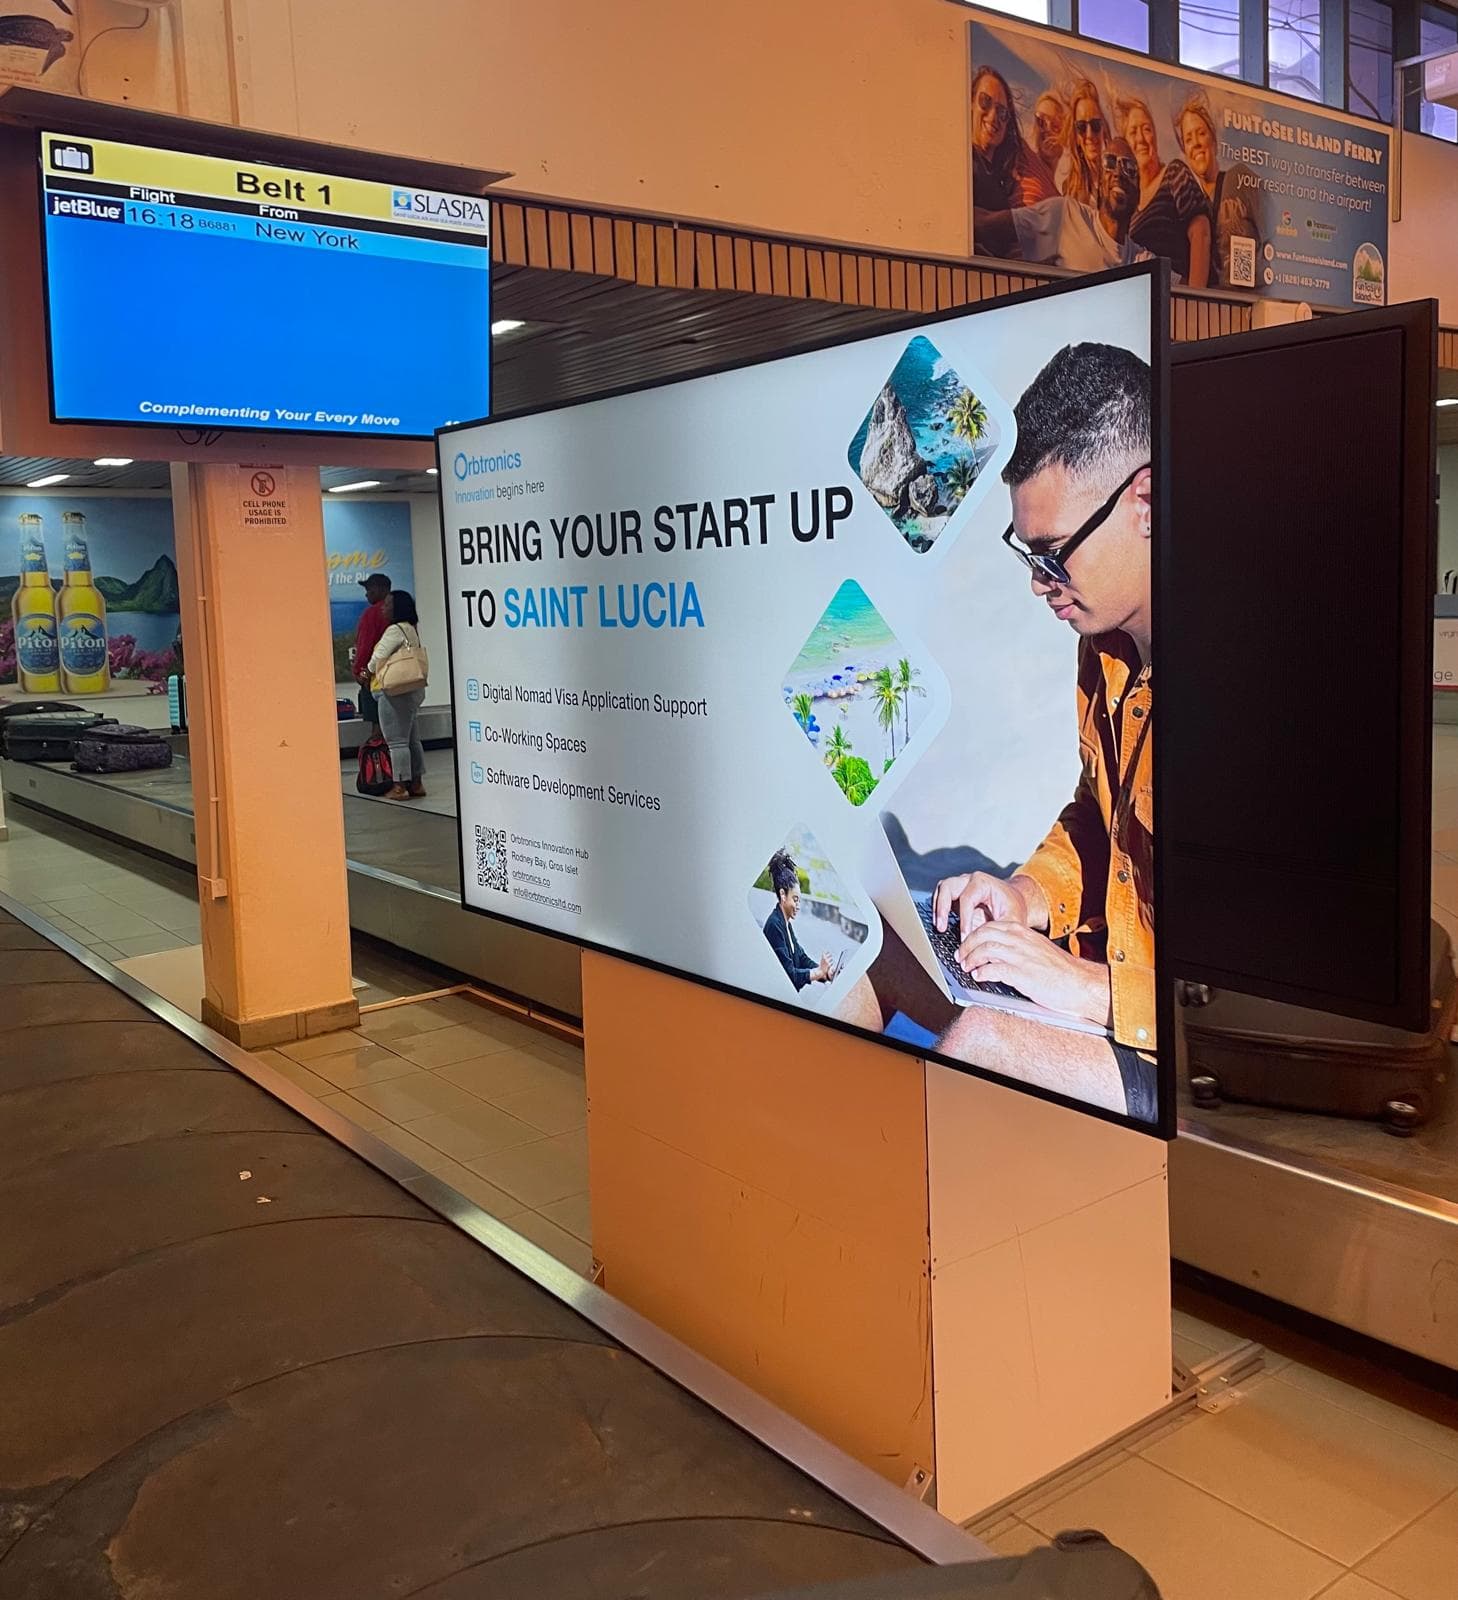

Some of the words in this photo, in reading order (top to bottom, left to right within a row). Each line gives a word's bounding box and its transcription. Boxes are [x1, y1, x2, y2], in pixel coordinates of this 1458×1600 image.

[1296, 126, 1342, 155] ISLAND
[1343, 137, 1383, 165] FERRY
[1220, 141, 1241, 160] The
[1241, 146, 1271, 166] BEST
[1270, 157, 1293, 175] way
[1294, 161, 1304, 175] to
[1304, 162, 1346, 184] transfer
[1345, 171, 1386, 195] between
[129, 186, 176, 205] Flight
[236, 171, 306, 203] Belt
[317, 184, 331, 206] 1
[1236, 172, 1262, 190] your
[1263, 177, 1295, 196] resort
[1296, 183, 1317, 201] and
[1318, 188, 1335, 205] the
[1336, 192, 1373, 213] airport!
[52, 197, 121, 220] jetBlue
[258, 204, 299, 221] From
[413, 194, 485, 222] SLASPA
[127, 206, 195, 231] 16:18
[198, 218, 238, 232] B6881
[255, 221, 306, 243] New
[312, 229, 360, 250] York
[139, 400, 271, 421] Complementing
[274, 408, 312, 422] Your
[314, 410, 357, 425] Every
[361, 413, 401, 427] Move
[454, 449, 522, 480] Orbtronics
[243, 500, 260, 509] CELL
[261, 501, 286, 509] PHONE
[455, 486, 495, 504] Innovation
[496, 482, 524, 501] begins
[525, 480, 545, 495] here
[244, 517, 287, 526] PROHIBITED
[248, 509, 273, 517] USAGE
[274, 509, 282, 517] IS
[458, 519, 543, 566] BRING
[549, 509, 643, 560] YOUR
[653, 493, 776, 554] START
[789, 485, 854, 544] UP
[326, 548, 388, 570] ome
[335, 572, 353, 586] the
[354, 572, 370, 586] Pit
[460, 589, 497, 629] TO
[503, 584, 589, 629] SAINT
[598, 580, 706, 629] LUCIA
[61, 636, 105, 649] Piton
[1433, 670, 1453, 683] ge
[482, 683, 513, 704] Digital
[515, 685, 552, 705] Nomad
[554, 688, 579, 706] Visa
[581, 690, 650, 712] Application
[653, 693, 708, 719] Support
[484, 725, 543, 751] Co-Working
[545, 732, 587, 753] Spaces
[486, 767, 530, 790] Software
[532, 774, 605, 801] Development
[608, 785, 661, 811] Services
[510, 833, 541, 849] Orbtronics
[541, 840, 574, 856] Innovation
[575, 847, 590, 860] Hub
[511, 850, 533, 867] Rodney
[534, 856, 548, 870] Bay,
[548, 859, 564, 873] Gros
[564, 864, 579, 876] Islet
[512, 869, 551, 887] orbtronics.co
[513, 886, 582, 913] info@orbtronicsltd.com
